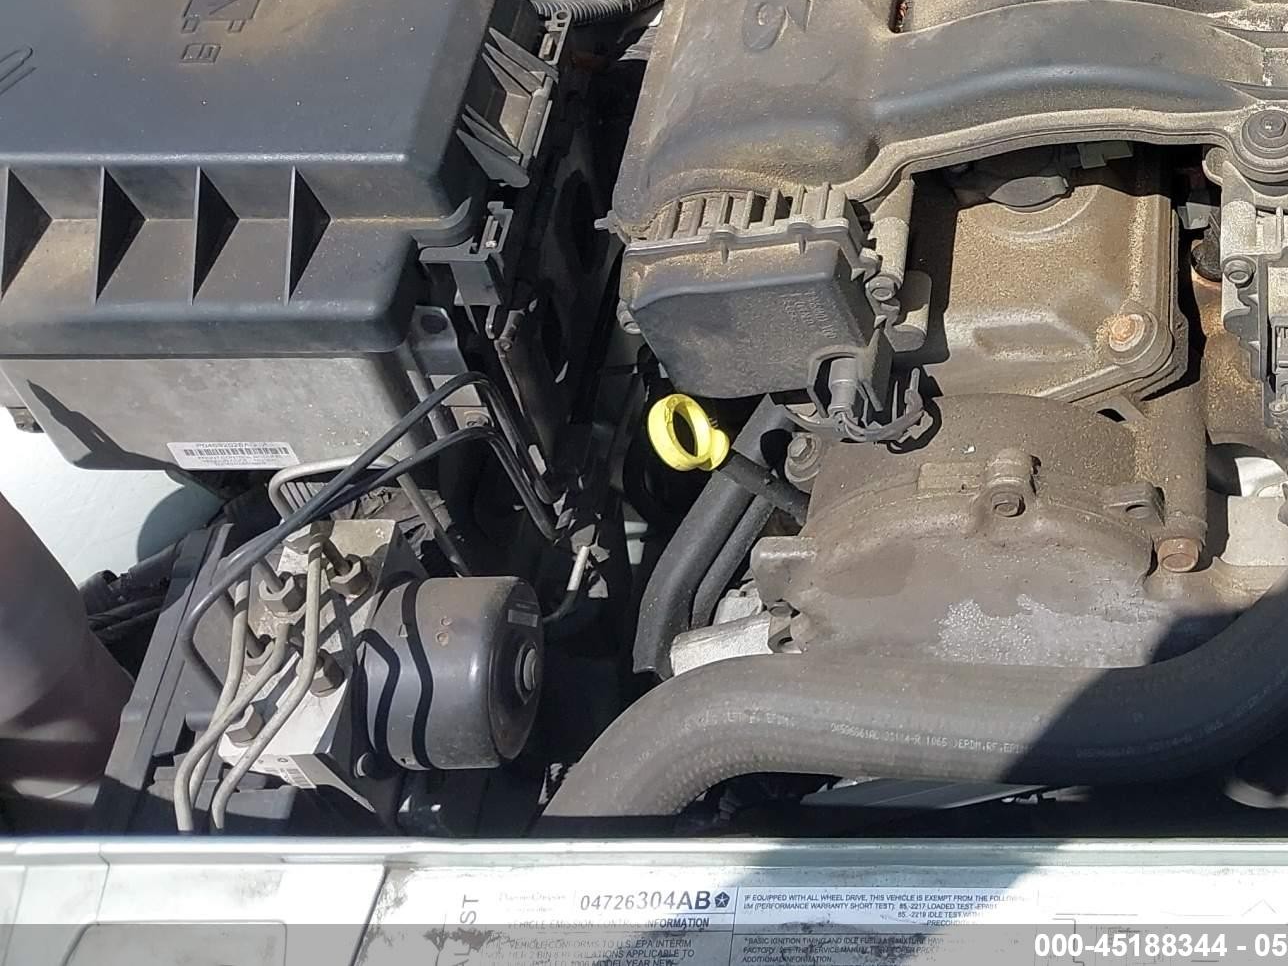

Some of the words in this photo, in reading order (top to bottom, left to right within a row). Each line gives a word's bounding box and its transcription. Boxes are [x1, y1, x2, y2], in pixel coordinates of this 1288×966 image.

[580, 890, 711, 911] 04726304AB
[846, 894, 868, 902] DRIVE,
[887, 894, 915, 902] VEHICLE
[924, 894, 952, 902] EXEMPT
[953, 894, 973, 902] FROM
[975, 894, 989, 902] THE
[810, 902, 848, 910] WARRANTY
[850, 902, 874, 910] SHORT
[644, 917, 710, 928] INFORMATION
[635, 939, 654, 948] EPA
[655, 939, 692, 948] INTERIM
[625, 949, 680, 958] APPLICABLE
[683, 949, 695, 958] TO
